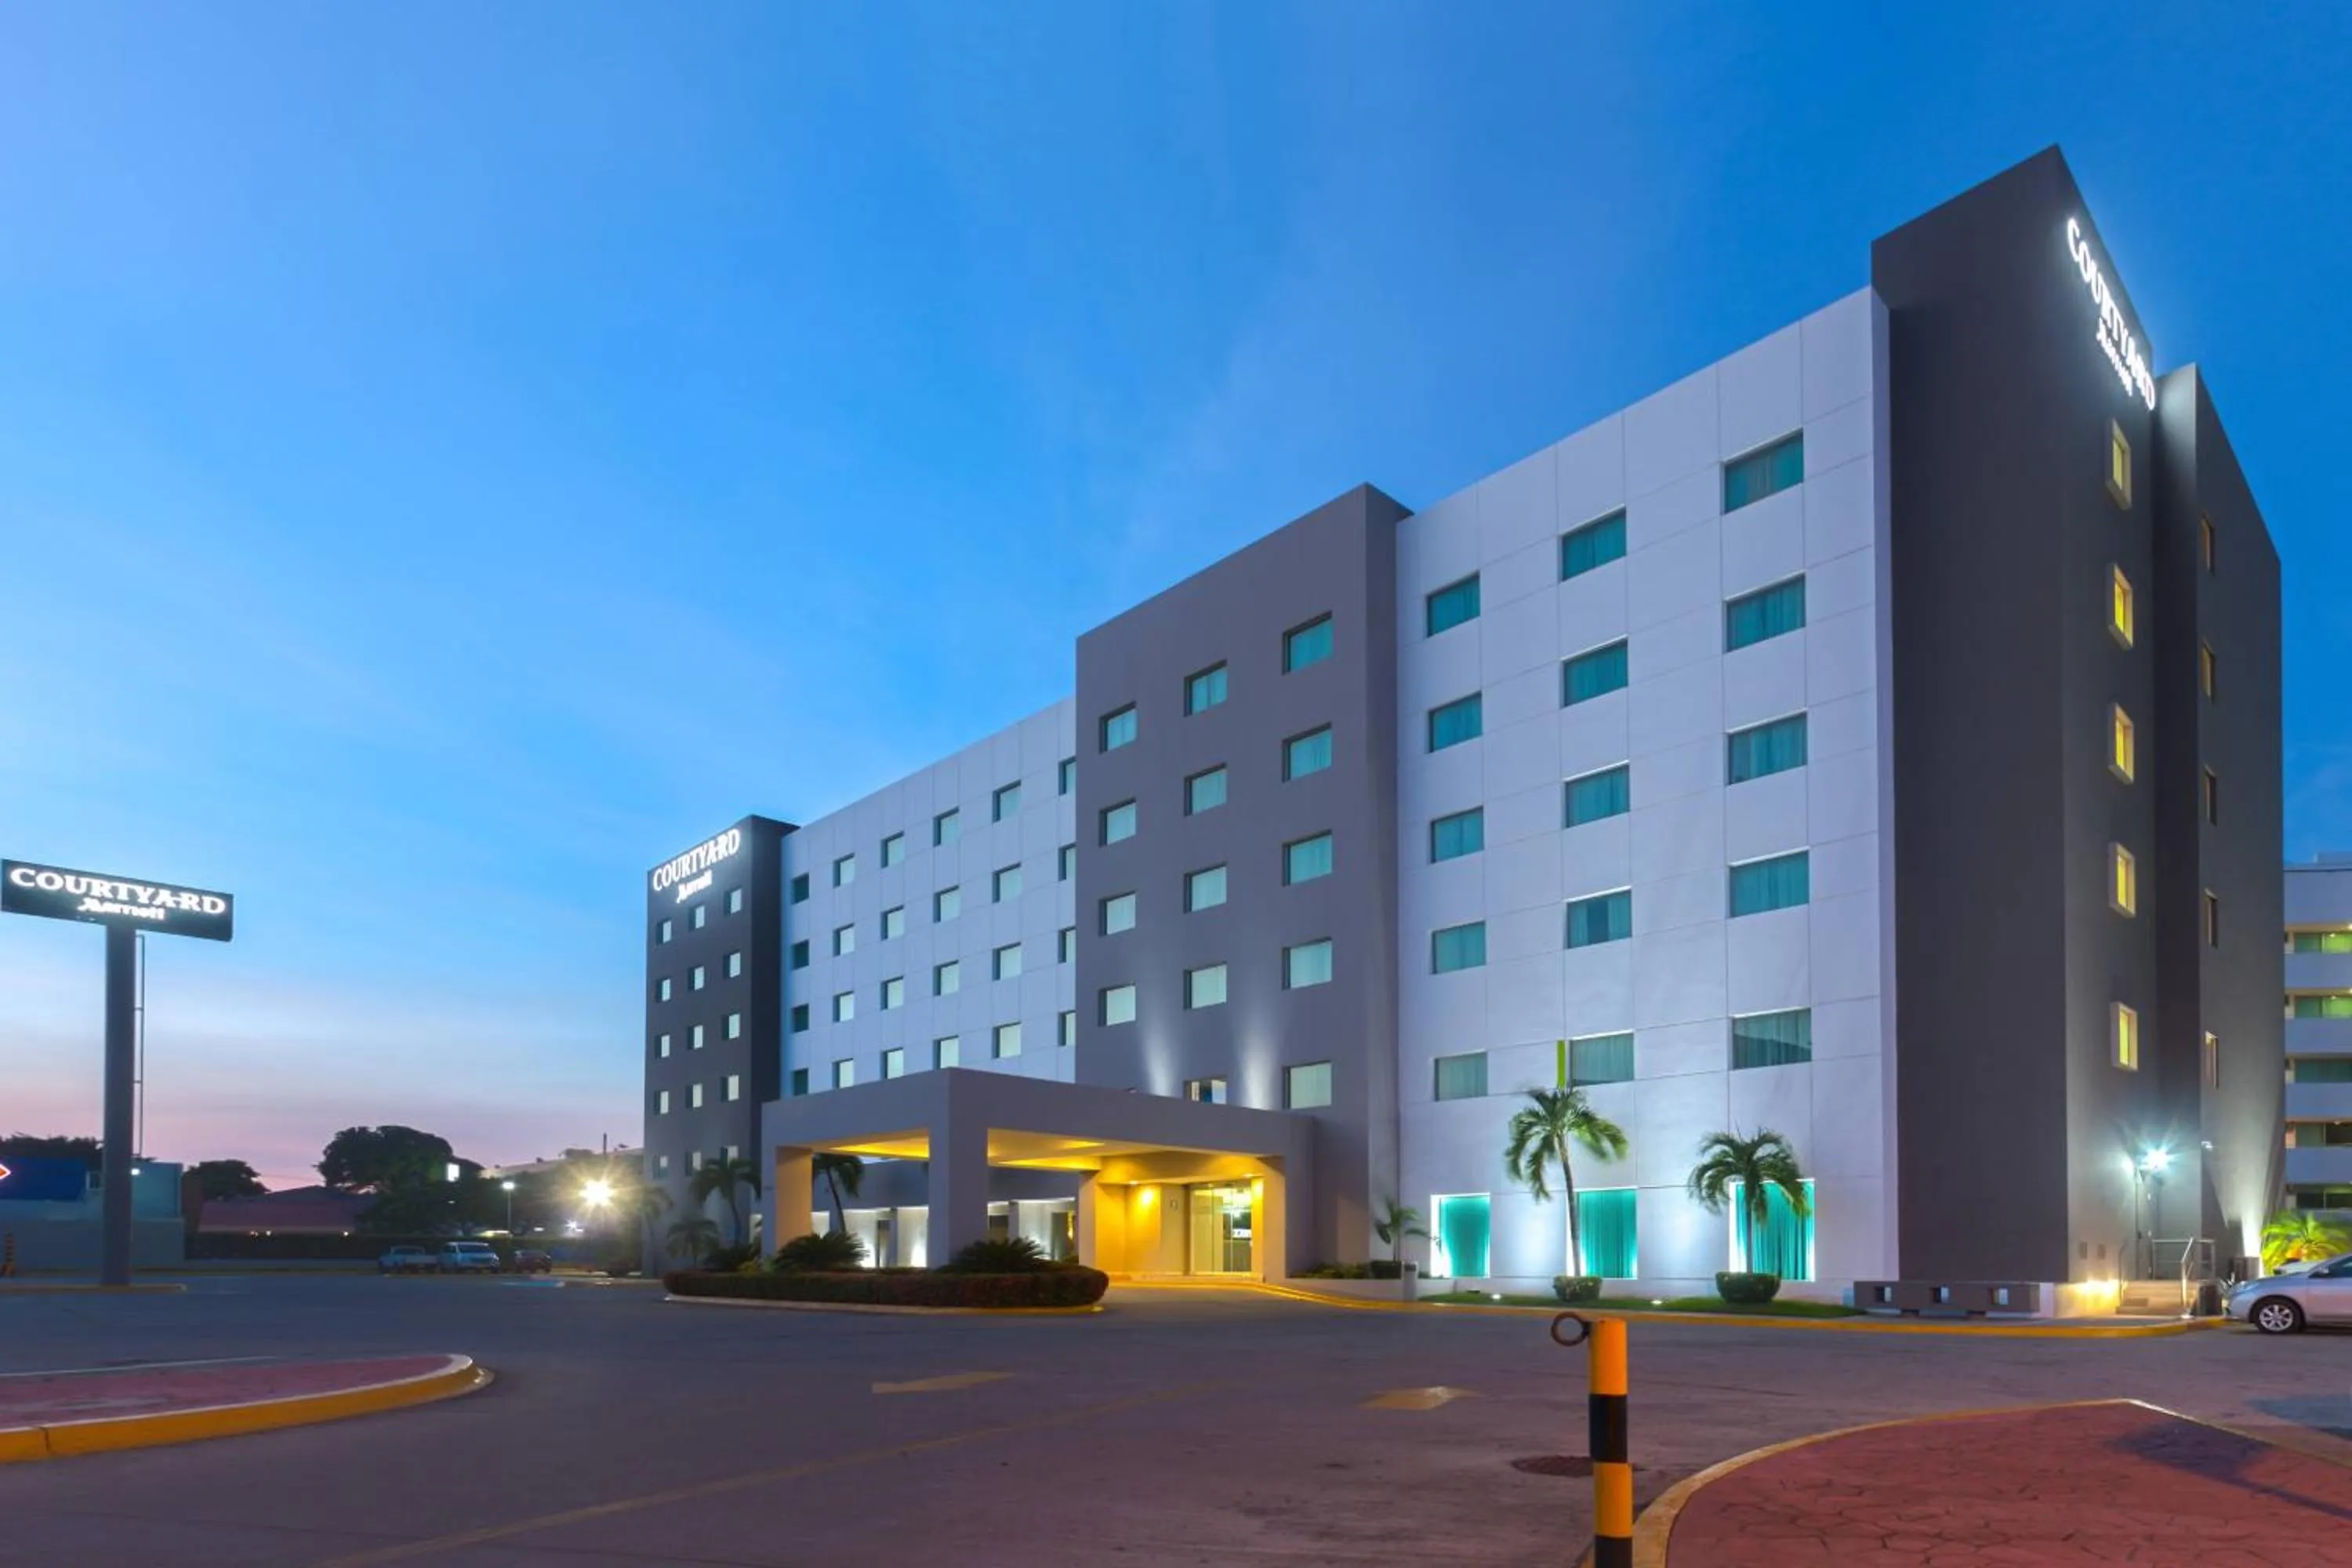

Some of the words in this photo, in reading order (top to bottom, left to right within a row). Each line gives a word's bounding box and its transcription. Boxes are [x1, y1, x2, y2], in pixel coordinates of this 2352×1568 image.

[2067, 217, 2156, 411] COURTYARD
[9, 867, 226, 914] COURTYARD
[652, 828, 741, 891] COURTYARD
